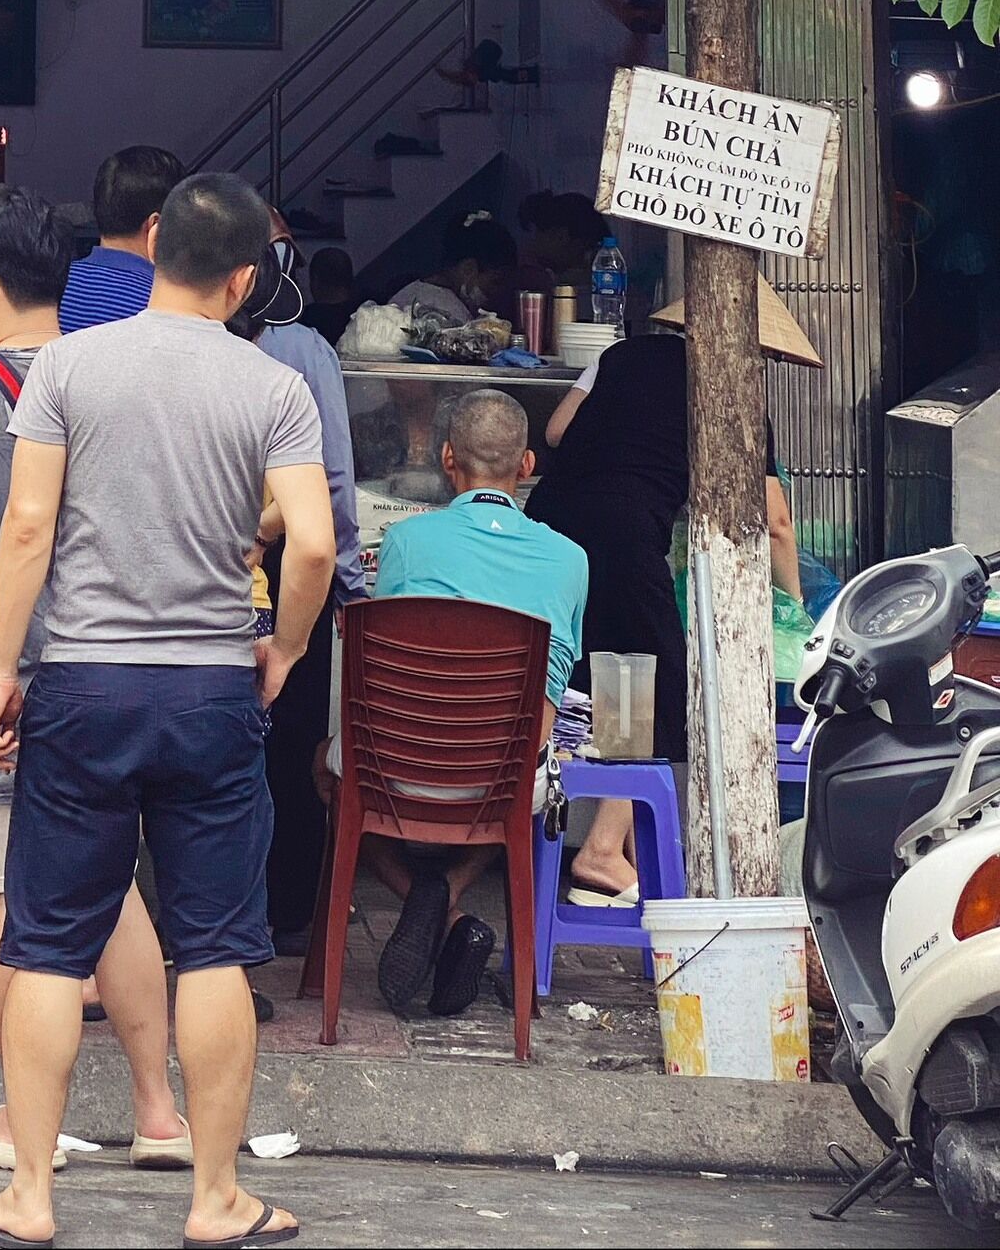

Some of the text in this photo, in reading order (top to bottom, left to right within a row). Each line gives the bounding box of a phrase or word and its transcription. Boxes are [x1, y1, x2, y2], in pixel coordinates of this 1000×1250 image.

[657, 83, 804, 136] KHÁCH ĂN
[663, 119, 782, 167] BÚN CHẢ
[628, 162, 802, 219] KHÁCH TỰ TÌM
[657, 149, 704, 169] KHÔNG
[760, 173, 778, 186] XE
[781, 176, 791, 189] Ô
[794, 181, 812, 194] TÔ
[616, 190, 804, 249] CHỖ ĐỖ XE Ô TÔ
